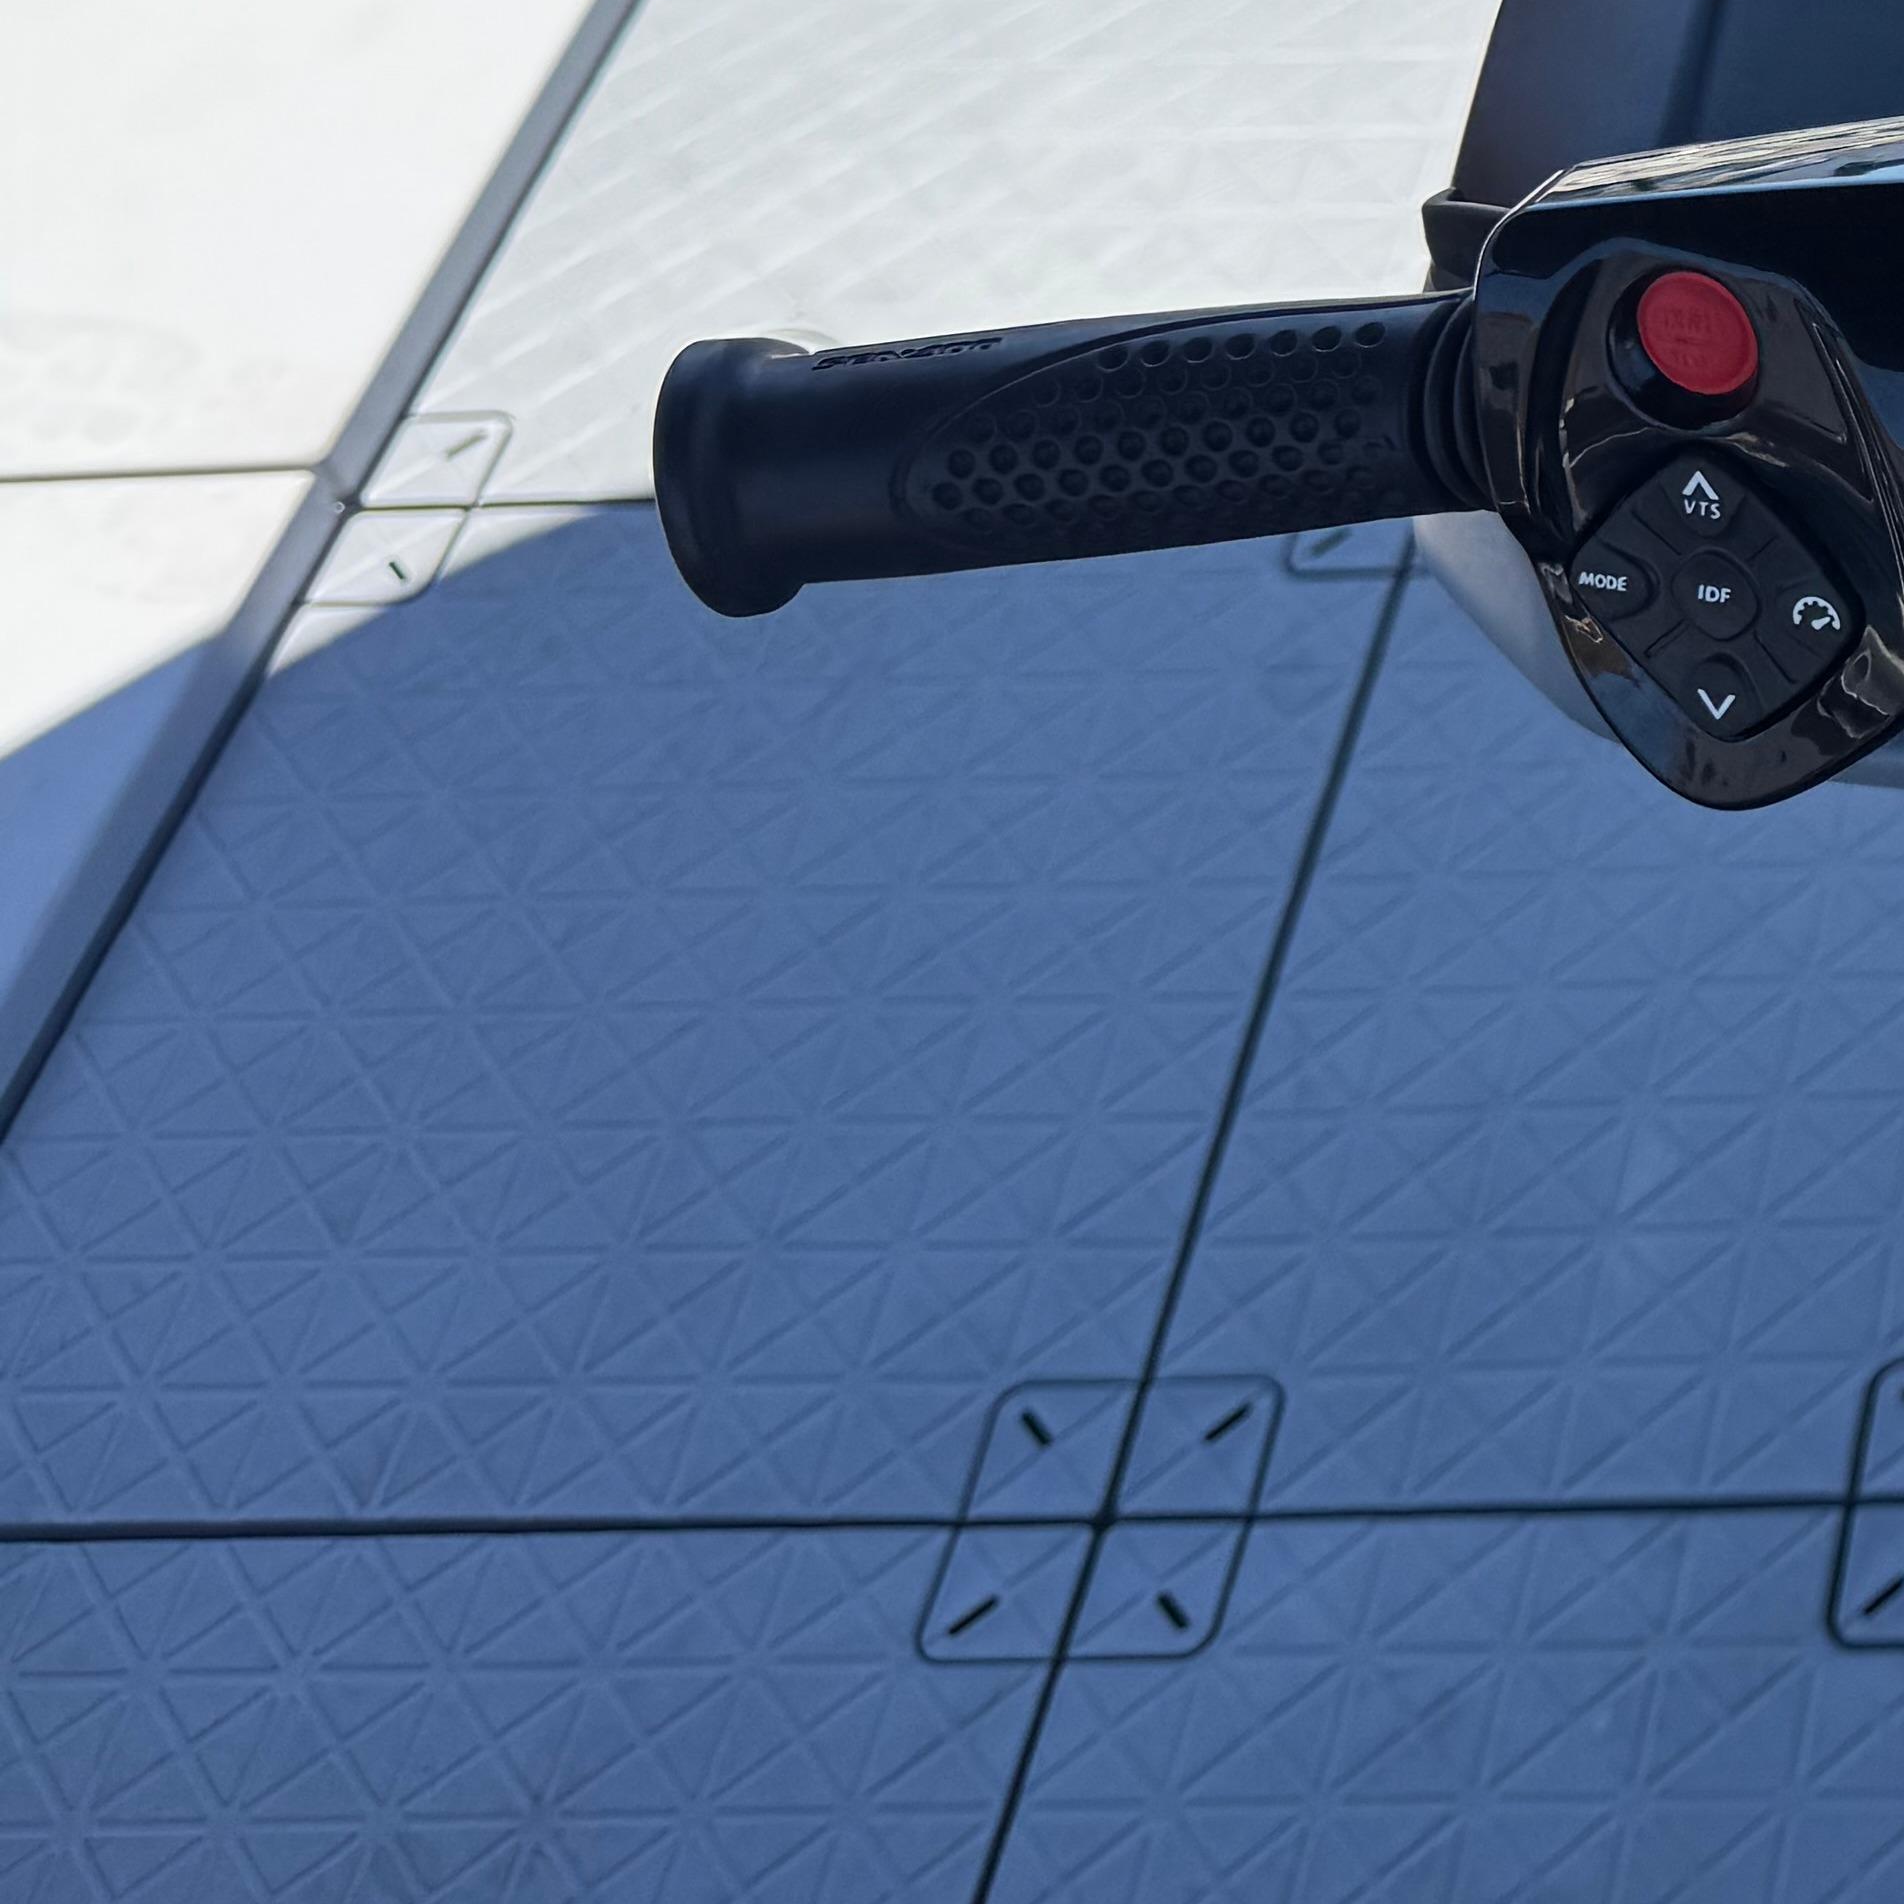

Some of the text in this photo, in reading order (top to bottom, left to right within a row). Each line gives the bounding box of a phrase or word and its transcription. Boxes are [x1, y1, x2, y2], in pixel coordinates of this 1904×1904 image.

[1684, 499, 1721, 520] VTS
[1578, 571, 1627, 592] MODE
[1697, 584, 1731, 603] IDF
